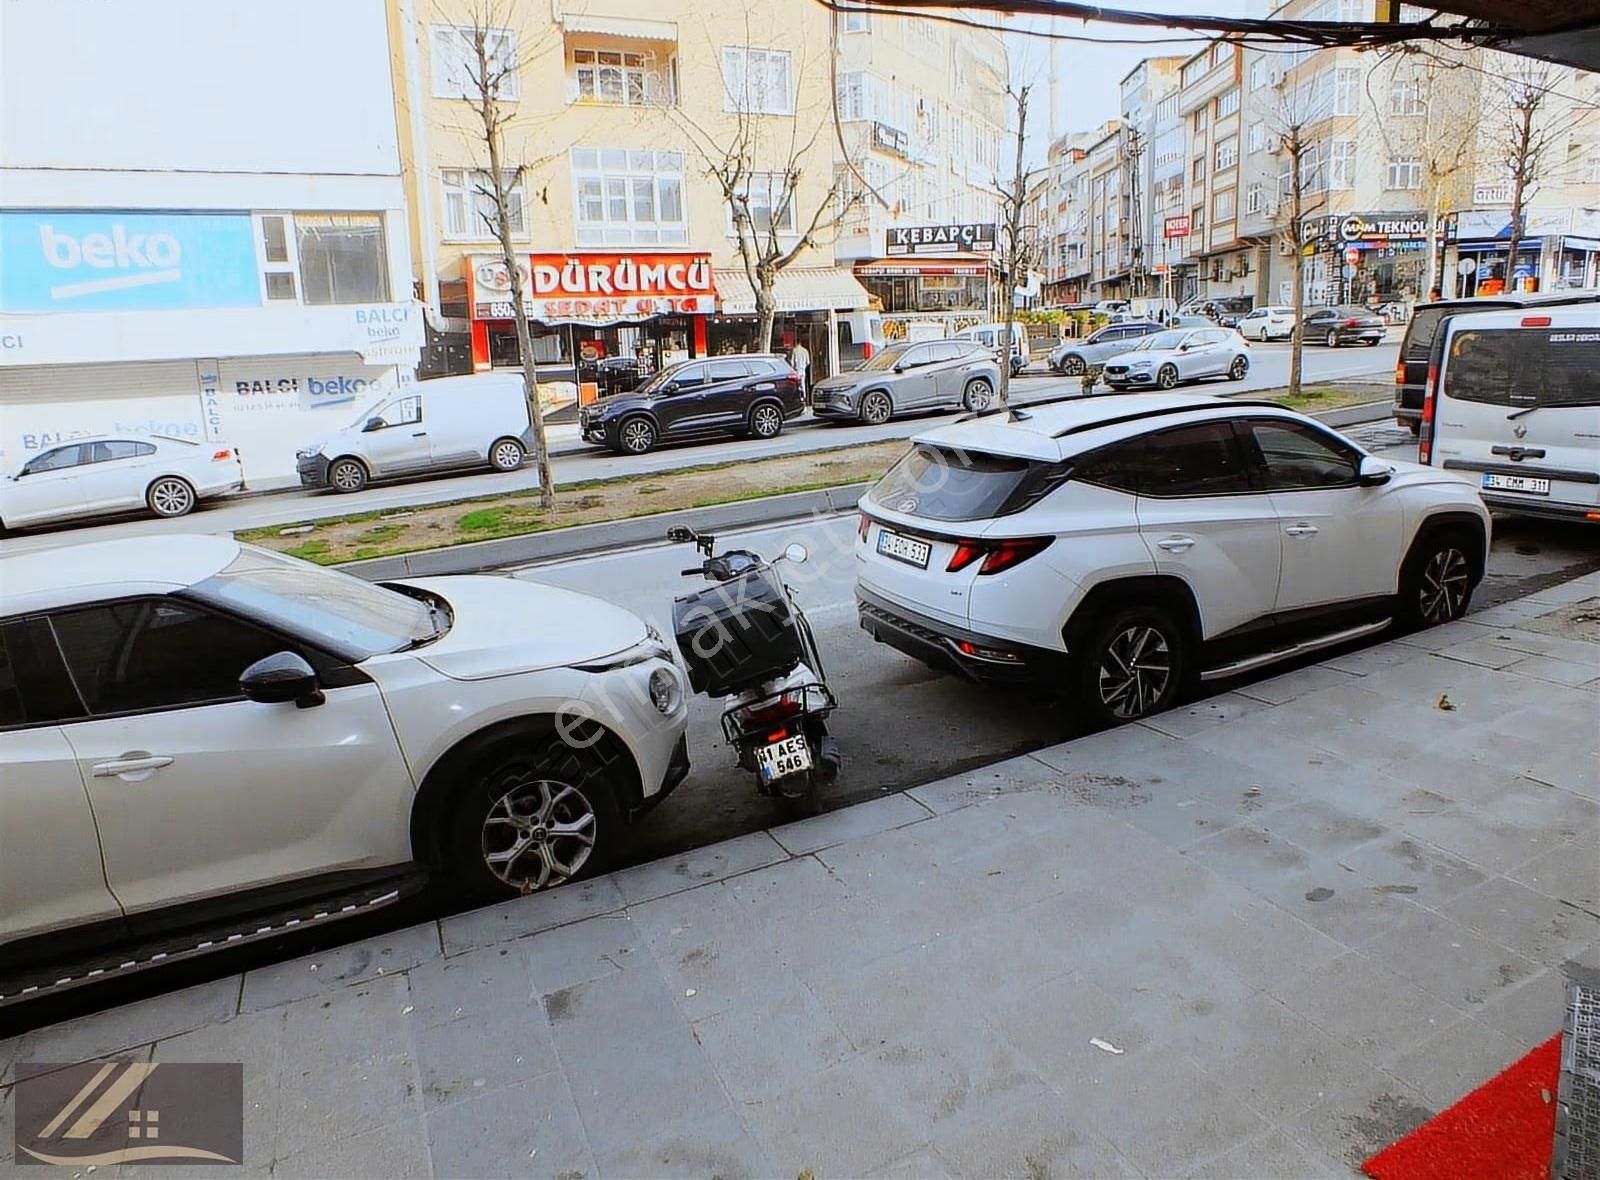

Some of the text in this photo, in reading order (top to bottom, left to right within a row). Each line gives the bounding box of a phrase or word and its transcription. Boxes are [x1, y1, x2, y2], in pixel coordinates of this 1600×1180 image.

[896, 226, 982, 245] KEBAPÇI
[38, 223, 181, 269] beko
[534, 258, 710, 294] DÜRÜMCÜ
[543, 298, 628, 315] SEDAT
[636, 297, 699, 314] USTA
[356, 308, 408, 323] BALCI
[368, 325, 400, 337] beko
[236, 378, 298, 396] BALCI
[778, 738, 805, 757] AES
[777, 755, 802, 773] 546
